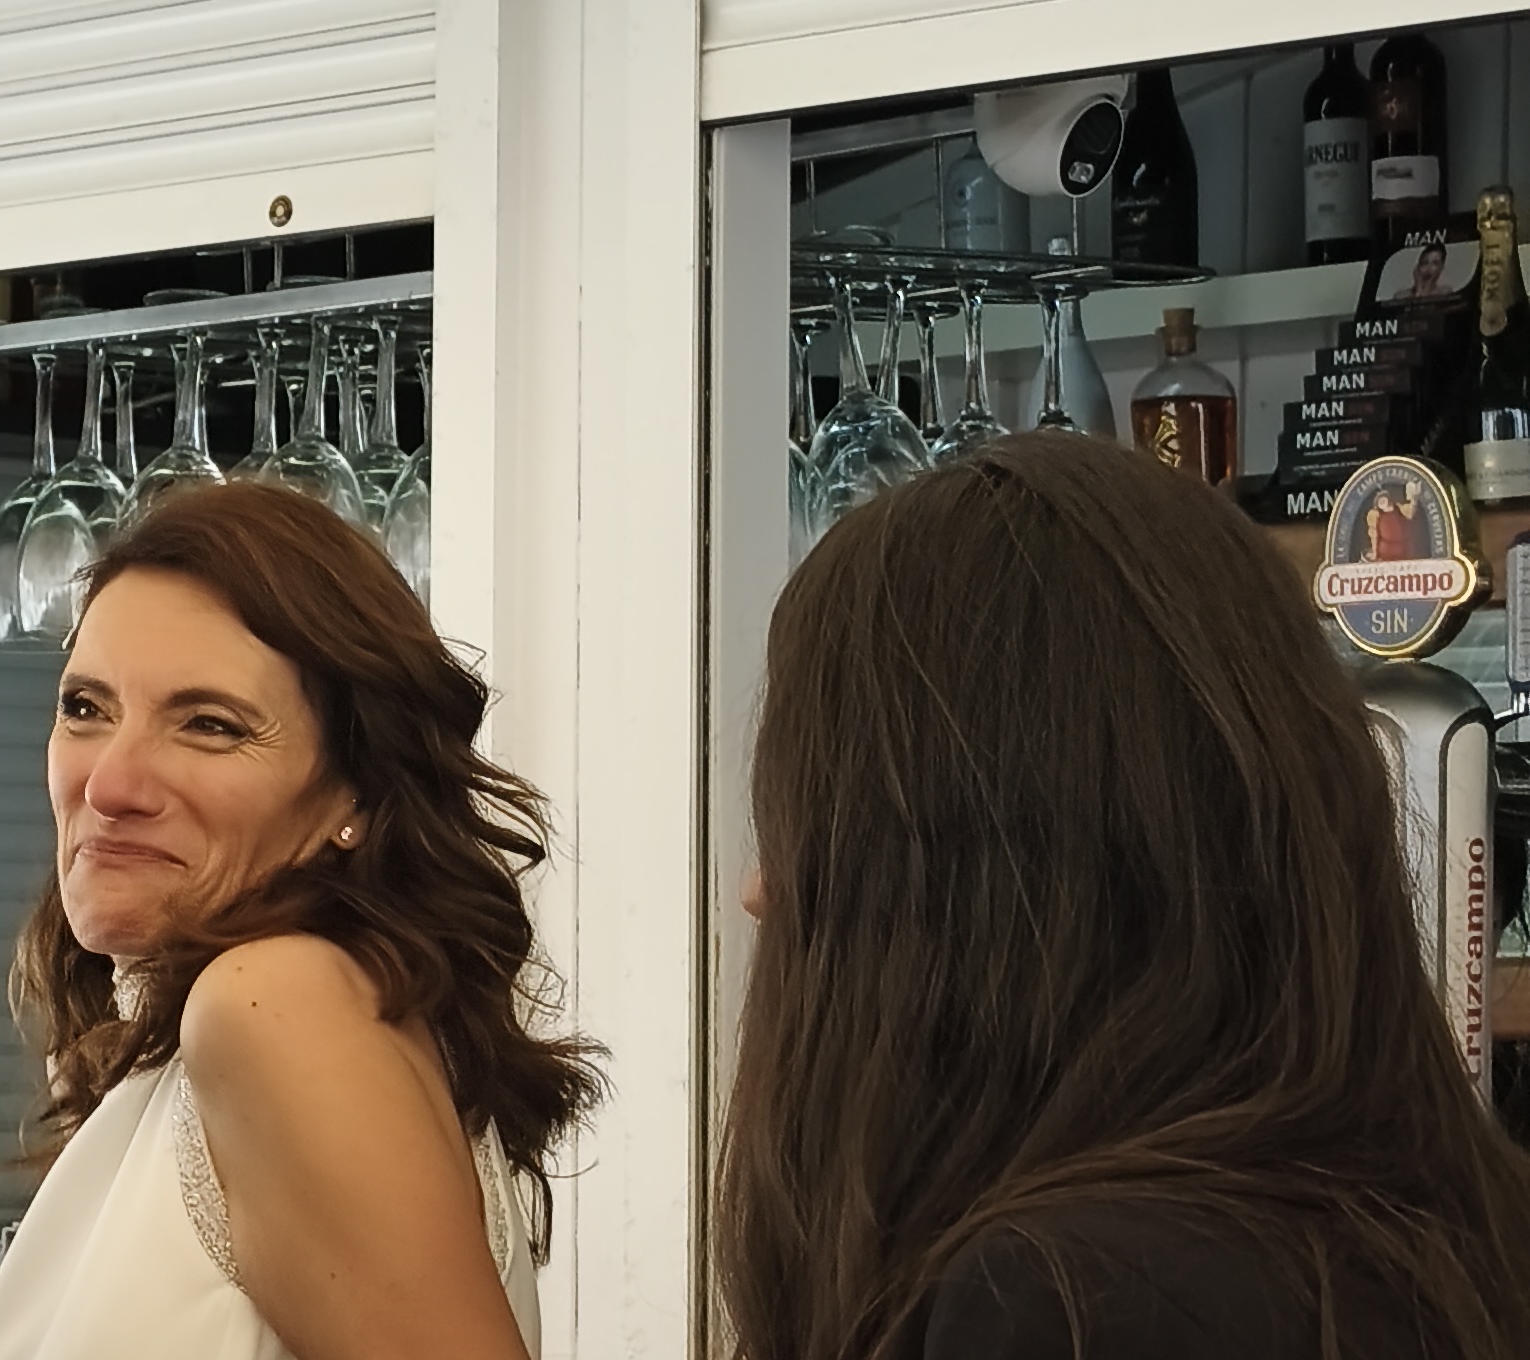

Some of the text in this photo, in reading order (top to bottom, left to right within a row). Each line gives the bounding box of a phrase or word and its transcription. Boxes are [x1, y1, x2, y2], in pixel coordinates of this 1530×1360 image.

[1405, 228, 1447, 247] MAN
[1356, 319, 1398, 338] MAN
[1333, 347, 1375, 365] MAN
[1323, 373, 1365, 392] MAN
[1302, 401, 1344, 420] MAN
[1296, 430, 1339, 449] MAN
[1327, 570, 1453, 596] Cruzcampo
[1371, 607, 1408, 635] SIN
